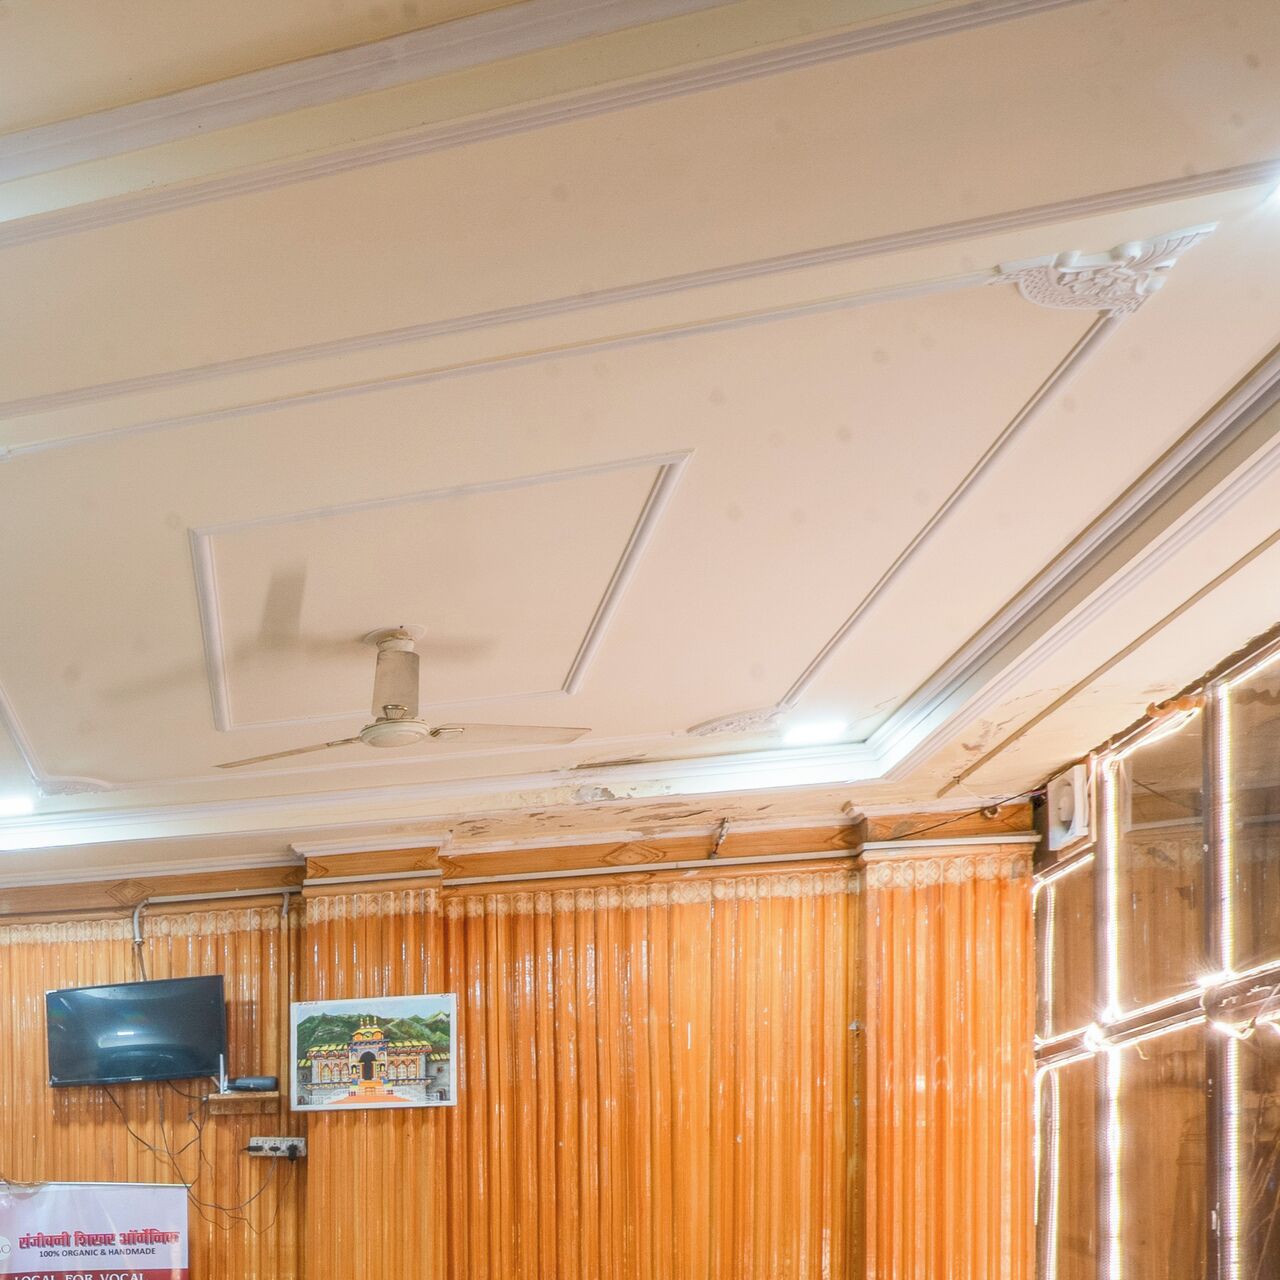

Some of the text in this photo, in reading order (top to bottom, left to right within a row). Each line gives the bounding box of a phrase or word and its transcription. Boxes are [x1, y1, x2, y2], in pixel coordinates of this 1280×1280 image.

[62, 1249, 99, 1257] ORGANIC
[100, 1248, 107, 1256] &
[108, 1247, 156, 1255] HANDMADE
